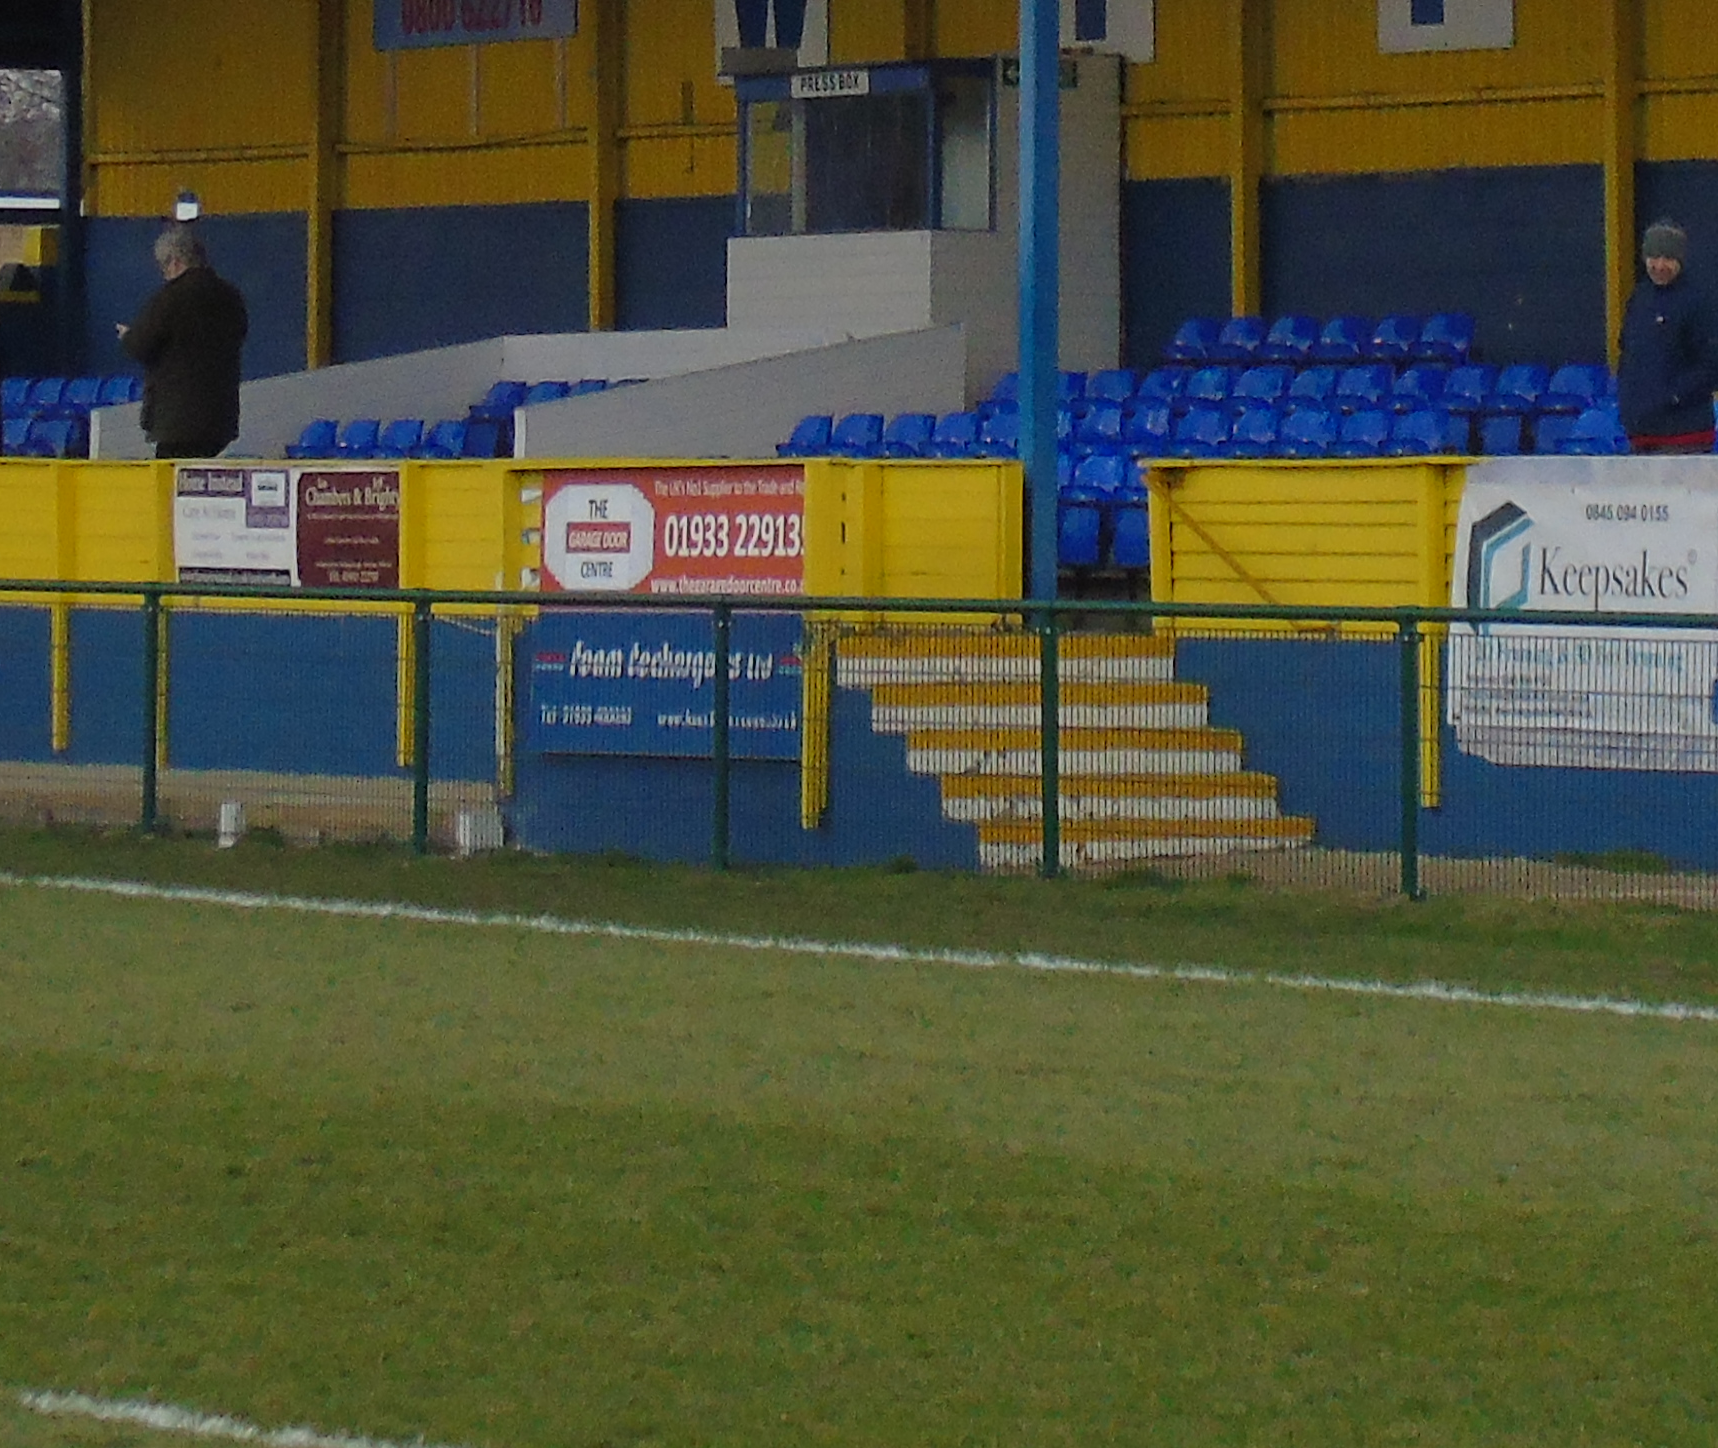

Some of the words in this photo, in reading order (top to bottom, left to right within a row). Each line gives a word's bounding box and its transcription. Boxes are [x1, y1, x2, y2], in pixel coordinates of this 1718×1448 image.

[801, 74, 835, 92] PRESS
[838, 73, 860, 90] BOX
[654, 480, 668, 495] The
[757, 480, 777, 495] Trade
[780, 480, 794, 495] and
[589, 498, 608, 519] THE
[1586, 504, 1613, 520] 0845
[1616, 504, 1637, 521] 094
[1641, 504, 1669, 522] 0155
[569, 530, 602, 548] GARAGE
[603, 531, 628, 549] DOOR
[664, 513, 729, 558] 01933
[581, 562, 613, 579] CENTRE
[1540, 545, 1689, 612] Keepsakes
[569, 639, 624, 678] foam
